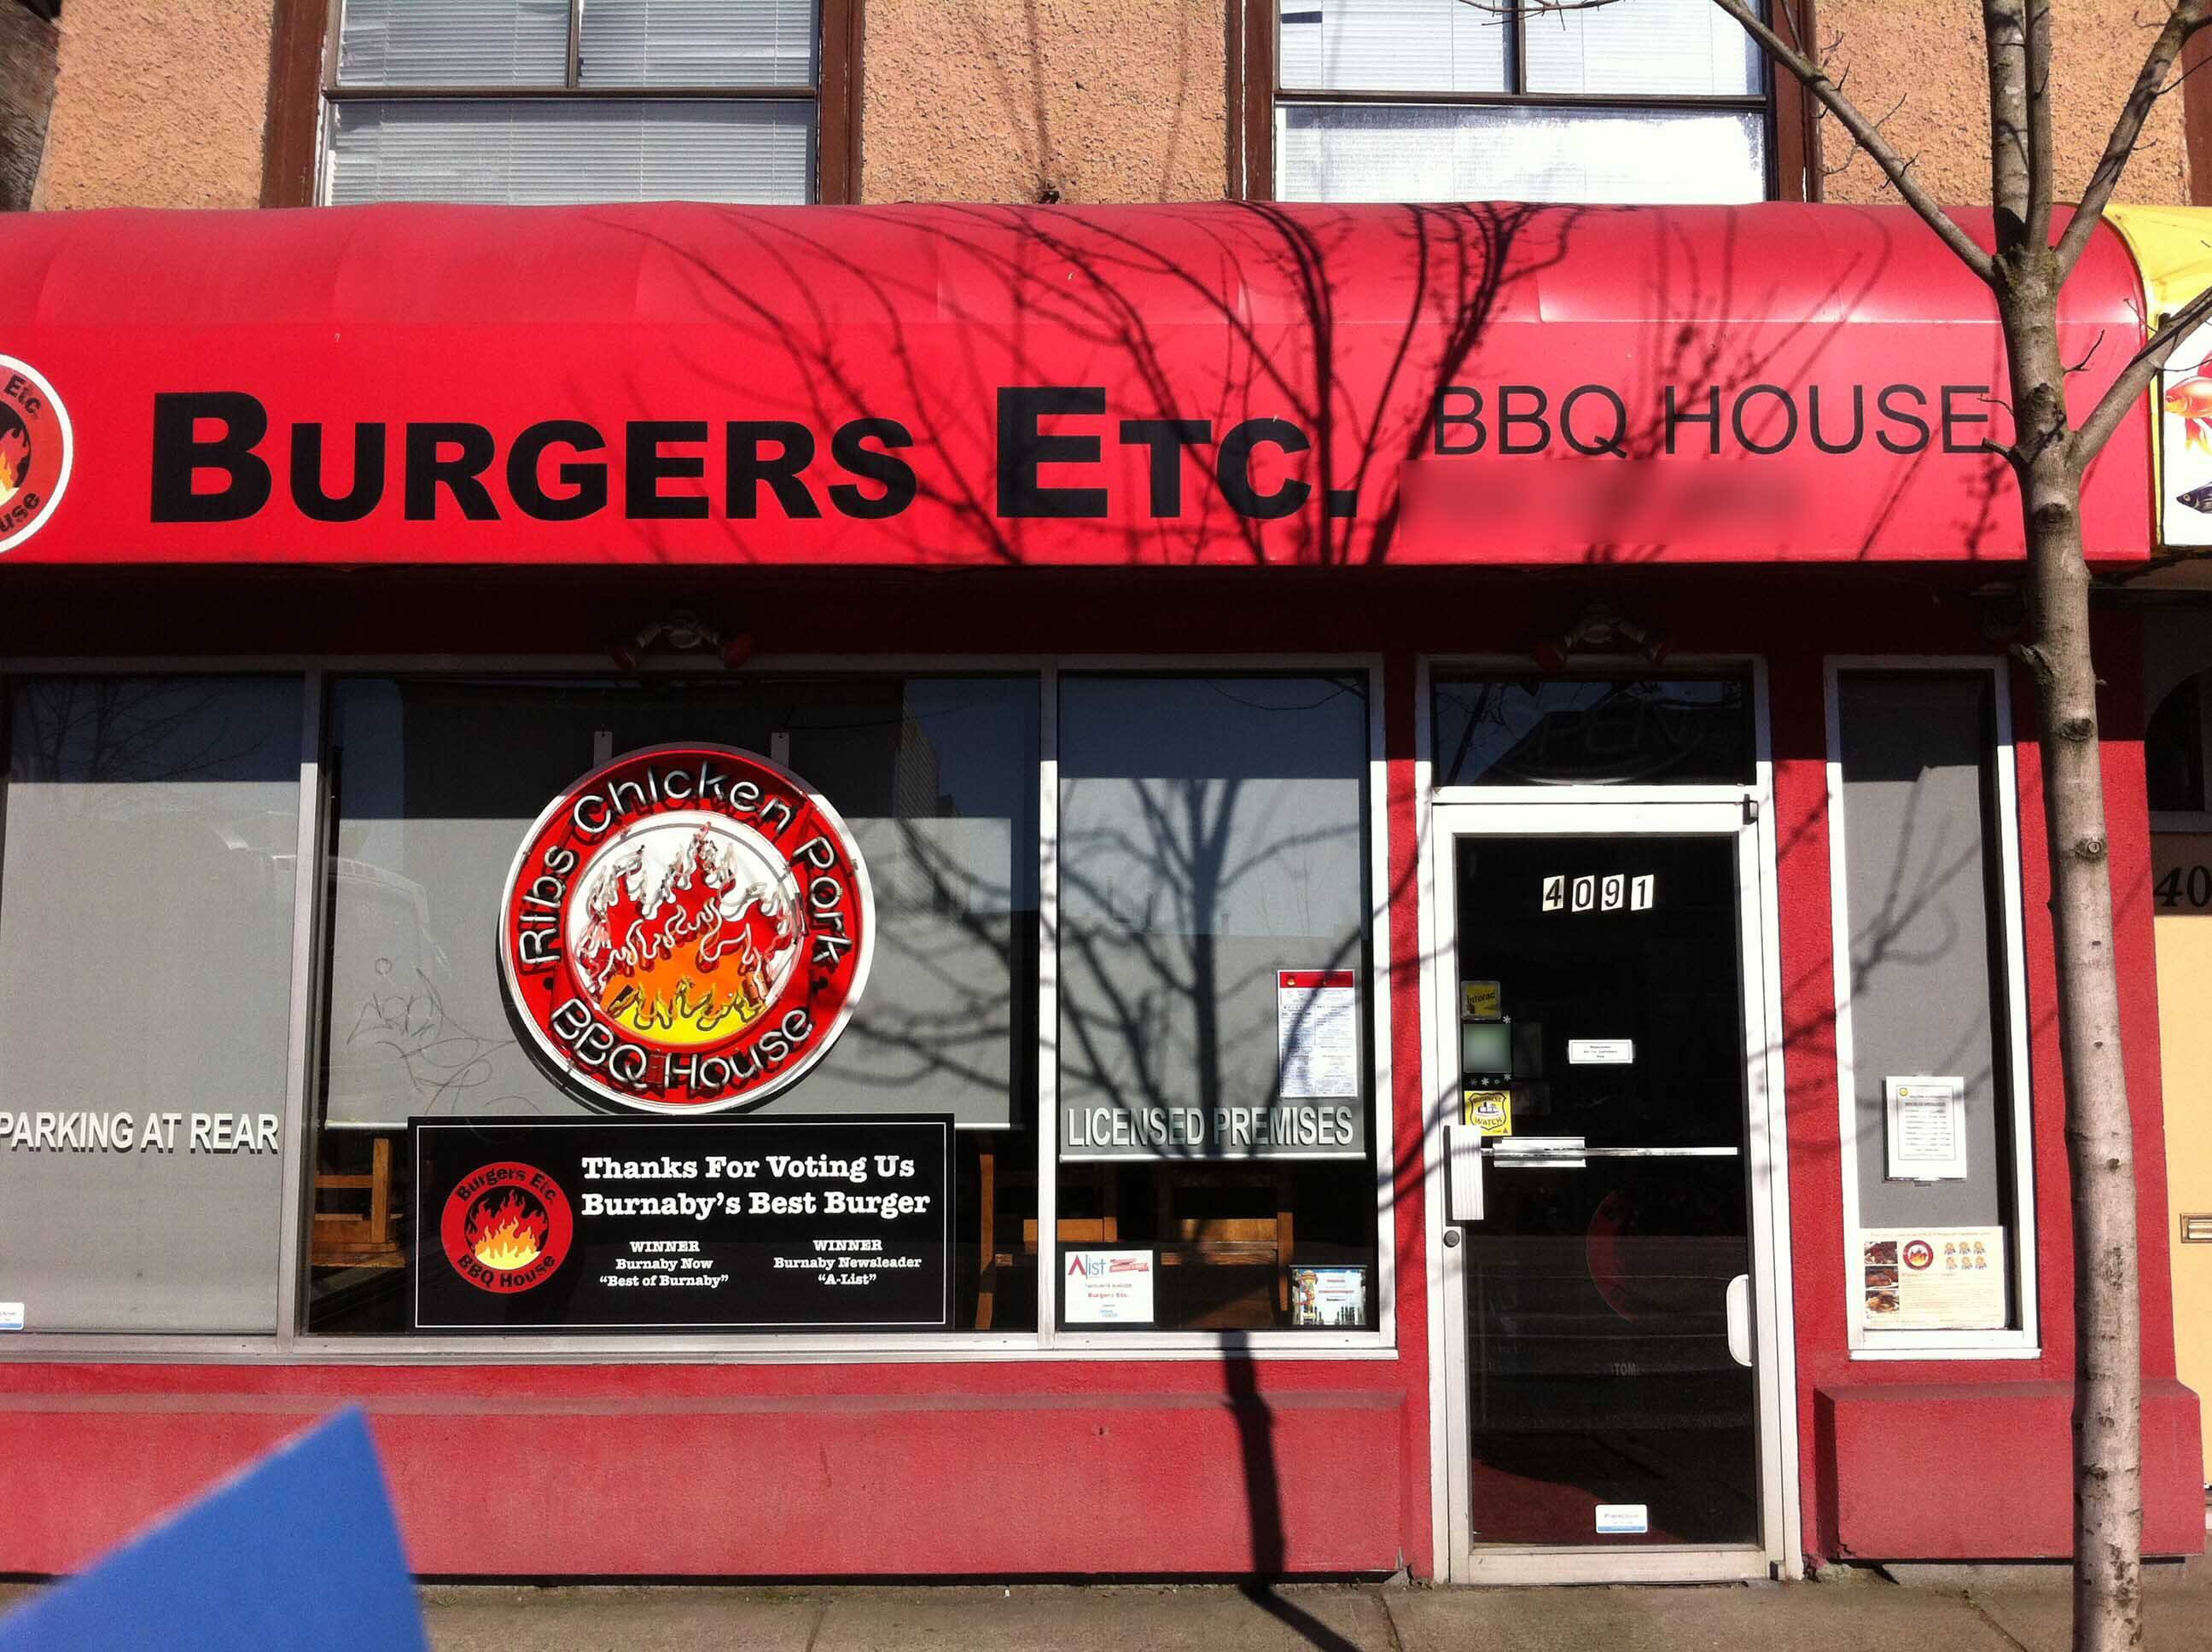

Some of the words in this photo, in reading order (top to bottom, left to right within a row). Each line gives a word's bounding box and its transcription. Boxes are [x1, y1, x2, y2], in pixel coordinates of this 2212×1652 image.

[1434, 384, 1632, 459] BBQ
[1666, 384, 1994, 455] HOUSE
[150, 391, 917, 522] BURGERS
[997, 387, 1357, 519] ETC.
[519, 845, 577, 965] Ribs
[573, 761, 794, 834] Chicken
[793, 836, 852, 965] Pork
[1545, 878, 1648, 909] 4091
[551, 998, 649, 1090] BBQ
[663, 1008, 812, 1090] House
[0, 1112, 133, 1149] PARKING
[140, 1113, 182, 1149] AT
[190, 1113, 279, 1150] REAR
[1068, 1108, 1205, 1146] LICENSED
[1214, 1106, 1353, 1145] PREMISES
[456, 1167, 527, 1201] Burgers
[581, 1156, 698, 1179] Thanks
[705, 1156, 760, 1179] For
[765, 1154, 867, 1183] Voting
[874, 1155, 916, 1178] Us
[581, 1192, 742, 1220] Burnaby’s
[748, 1192, 818, 1214] Best
[824, 1191, 931, 1219] Burger
[629, 1241, 700, 1253] WINNER
[812, 1240, 882, 1251] WINNER
[457, 1254, 495, 1288] BBQ
[499, 1255, 556, 1288] House
[615, 1259, 678, 1271] Burnaby
[680, 1258, 713, 1269] Now
[773, 1257, 836, 1271] Burnaby
[838, 1256, 923, 1268] Newsleader
[642, 1275, 658, 1287] of
